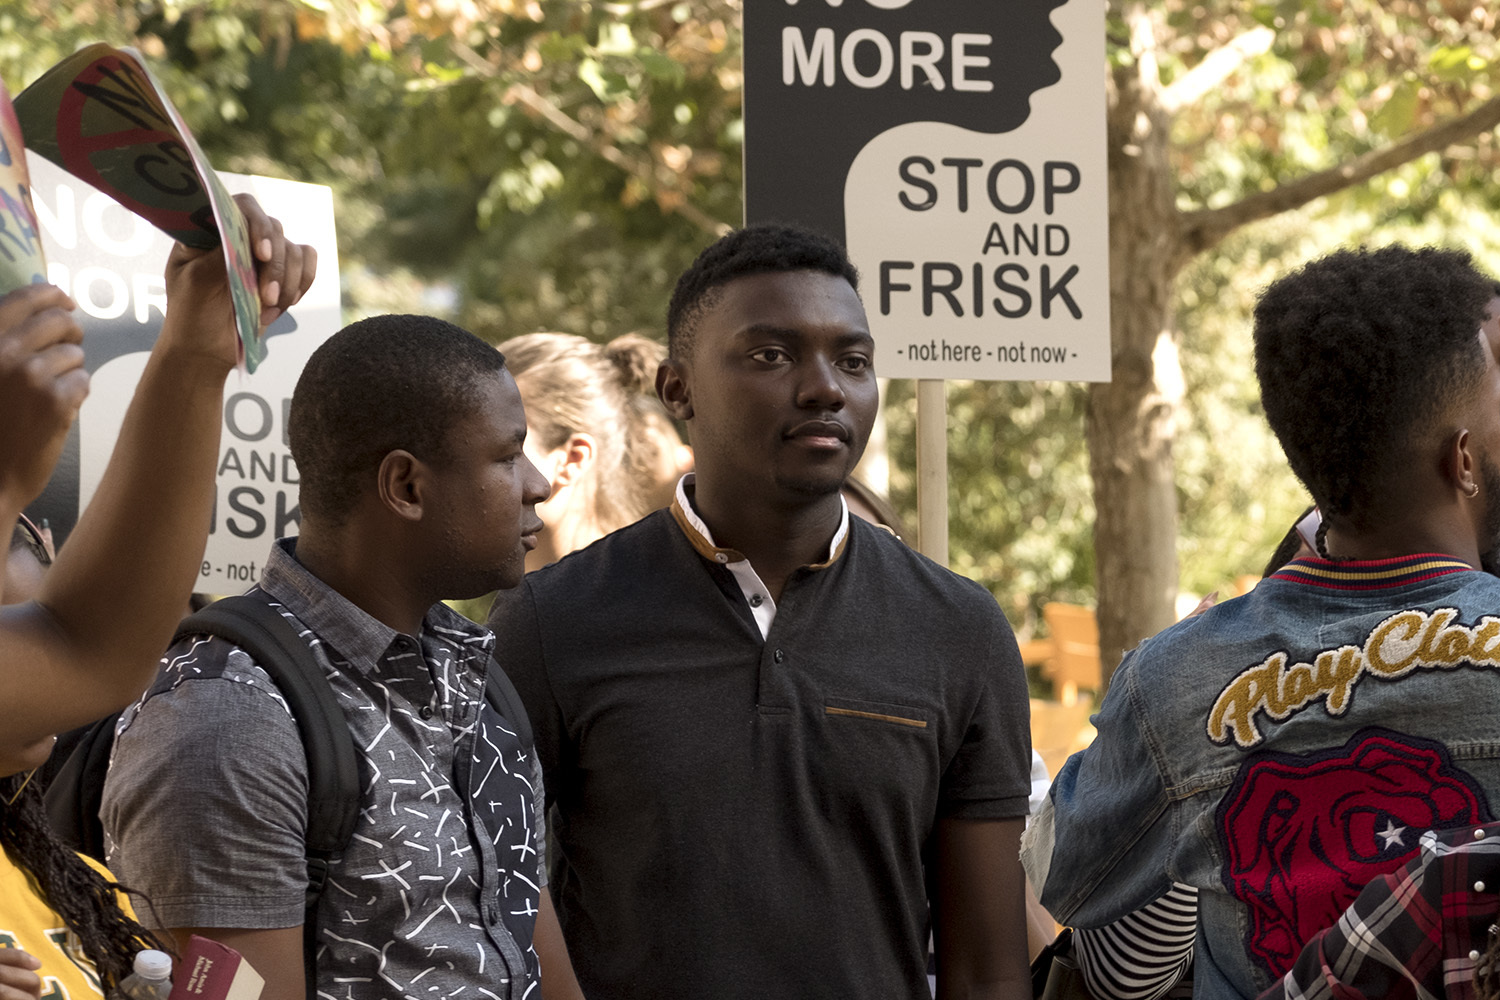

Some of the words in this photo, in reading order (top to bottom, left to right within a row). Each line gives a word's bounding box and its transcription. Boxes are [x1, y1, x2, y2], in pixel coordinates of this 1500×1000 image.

[782, 26, 994, 92] MORE
[898, 156, 1081, 215] STOP
[982, 222, 1070, 256] AND
[48, 262, 166, 324] OR
[879, 261, 1083, 320] FRISK
[908, 339, 938, 361] not
[942, 339, 982, 361] here
[997, 341, 1026, 362] not
[1031, 346, 1067, 363] now
[227, 561, 256, 582] not
[1207, 645, 1363, 747] Play
